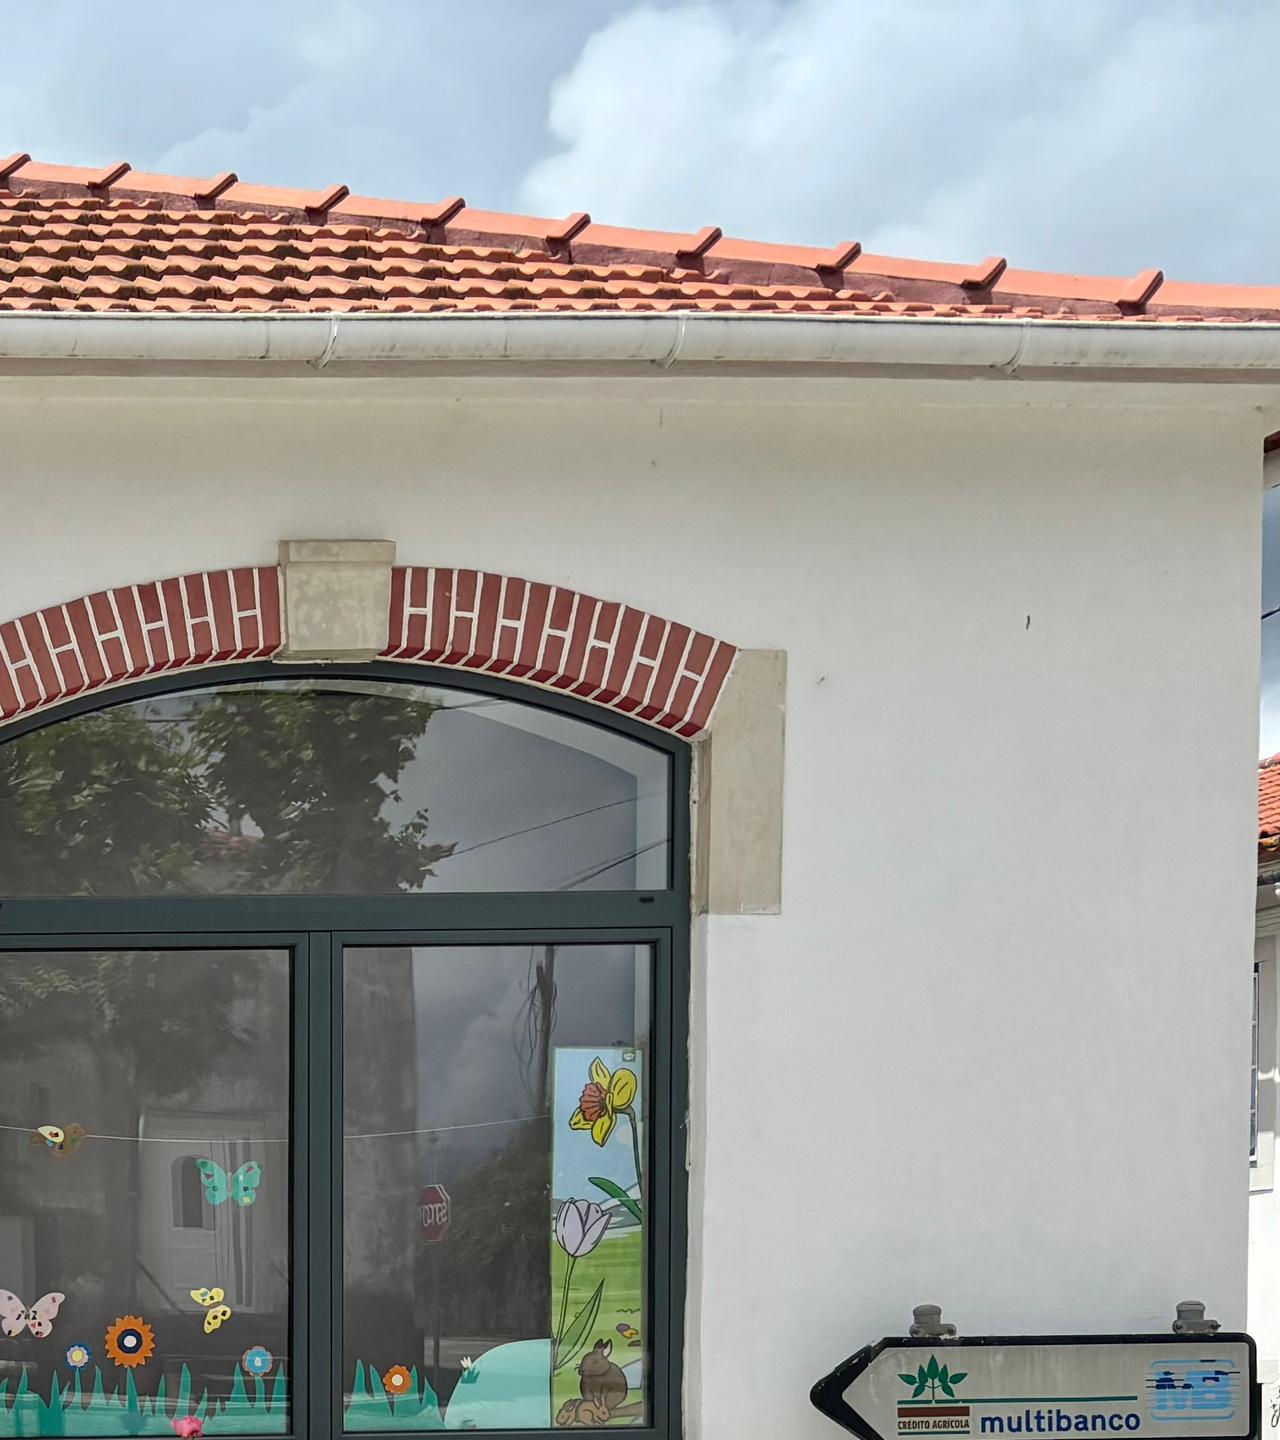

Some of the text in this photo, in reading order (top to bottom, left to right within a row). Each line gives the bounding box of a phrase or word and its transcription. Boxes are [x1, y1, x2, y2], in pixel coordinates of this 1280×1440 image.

[897, 1417, 971, 1430] CRÉDITO AGRÍCOLA
[981, 1408, 1141, 1433] multibanco
